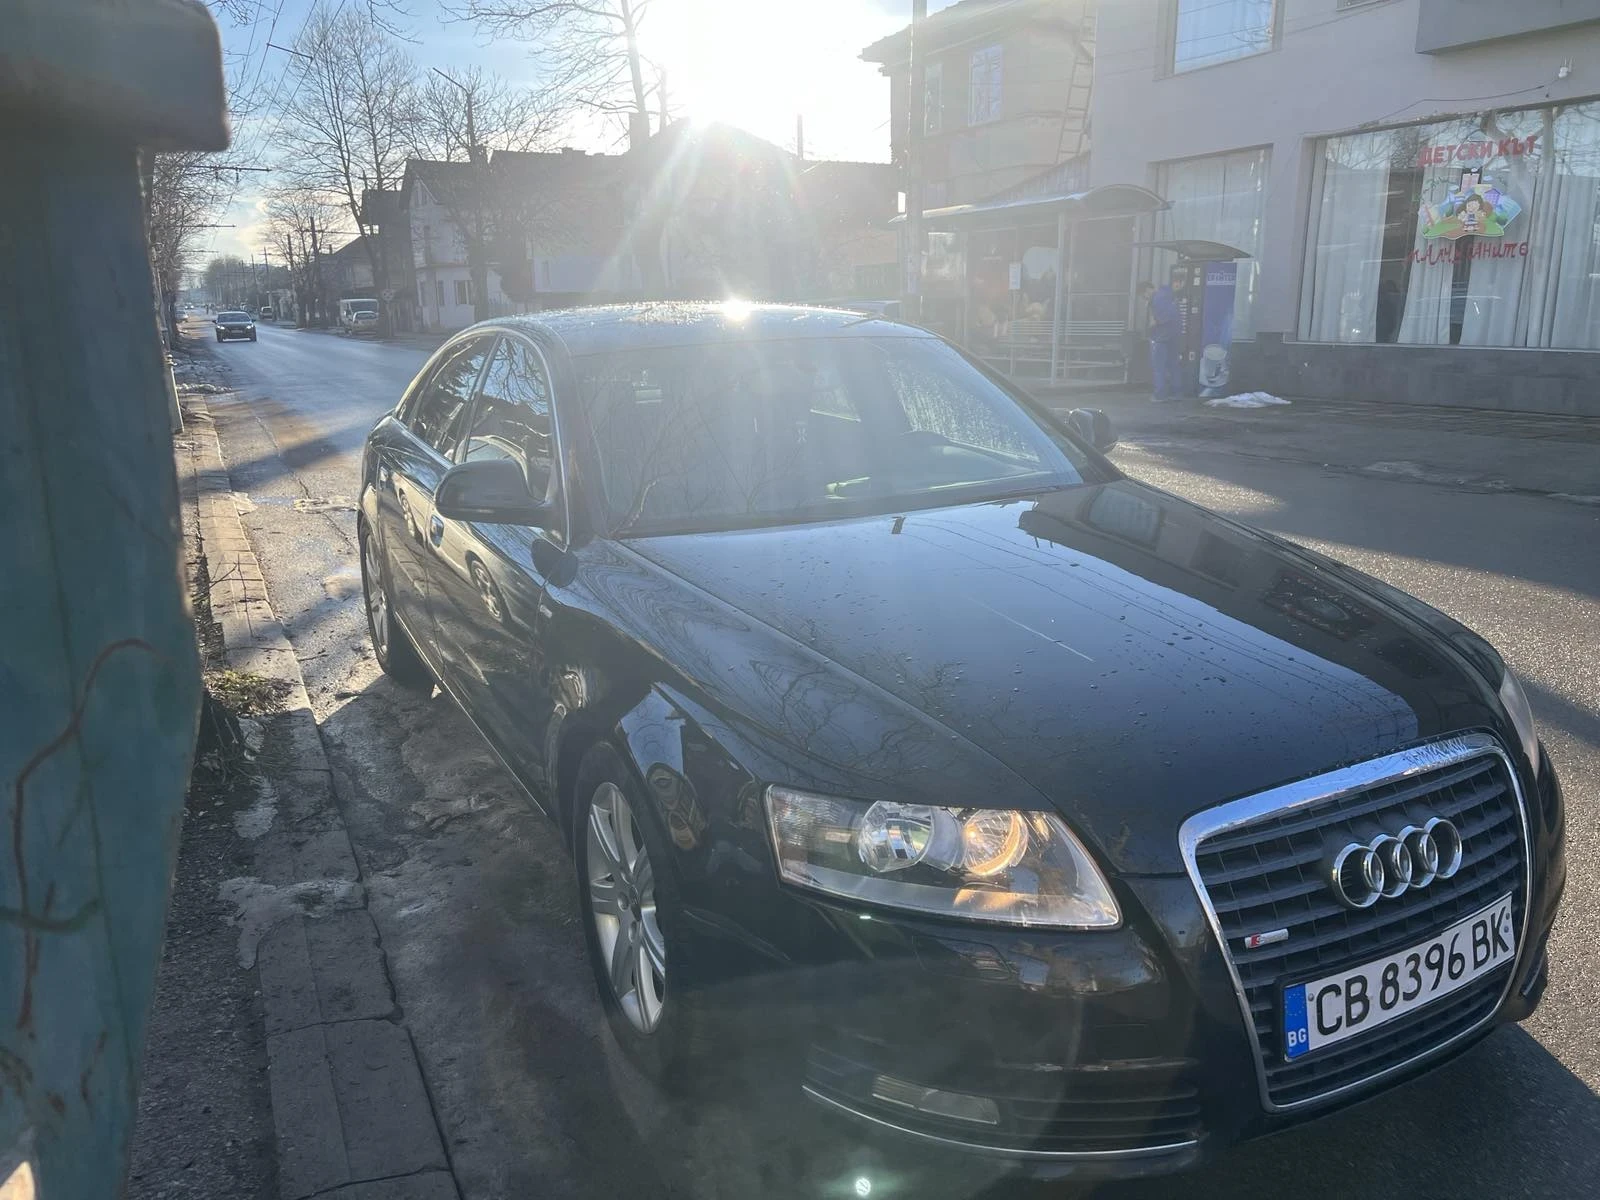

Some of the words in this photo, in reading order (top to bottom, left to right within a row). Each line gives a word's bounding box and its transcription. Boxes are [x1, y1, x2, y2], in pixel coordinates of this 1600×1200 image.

[1416, 141, 1493, 168] ДЕТСКИ
[1497, 135, 1537, 157] КЪТ
[1316, 975, 1370, 1036] CB
[1380, 933, 1466, 1011] 8396
[1472, 907, 1509, 971] BK
[1287, 1028, 1307, 1047] BG
